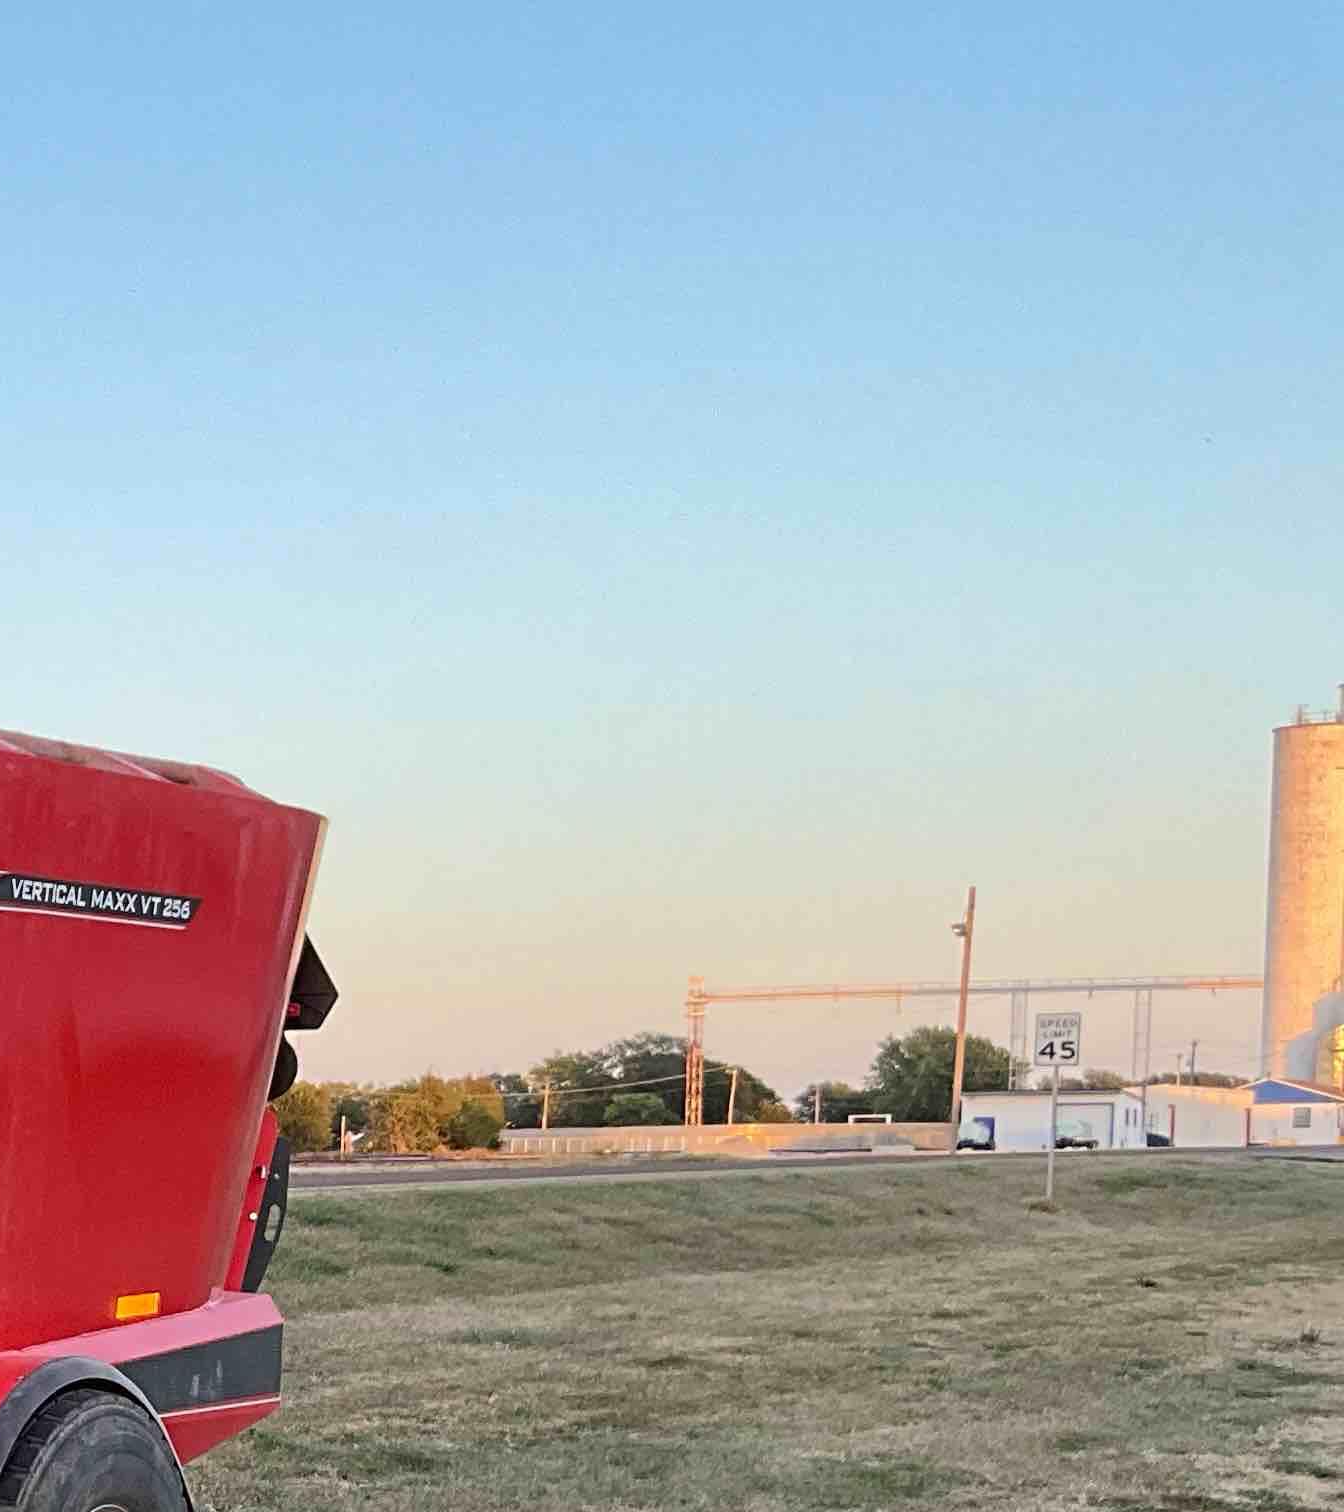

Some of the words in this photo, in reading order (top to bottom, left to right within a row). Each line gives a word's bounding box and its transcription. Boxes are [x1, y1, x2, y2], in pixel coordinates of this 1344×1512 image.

[11, 878, 87, 907] VERTICAL
[90, 889, 139, 913] MAXX
[141, 895, 162, 916] VT
[162, 899, 192, 919] 256
[1038, 1041, 1076, 1060] 45
